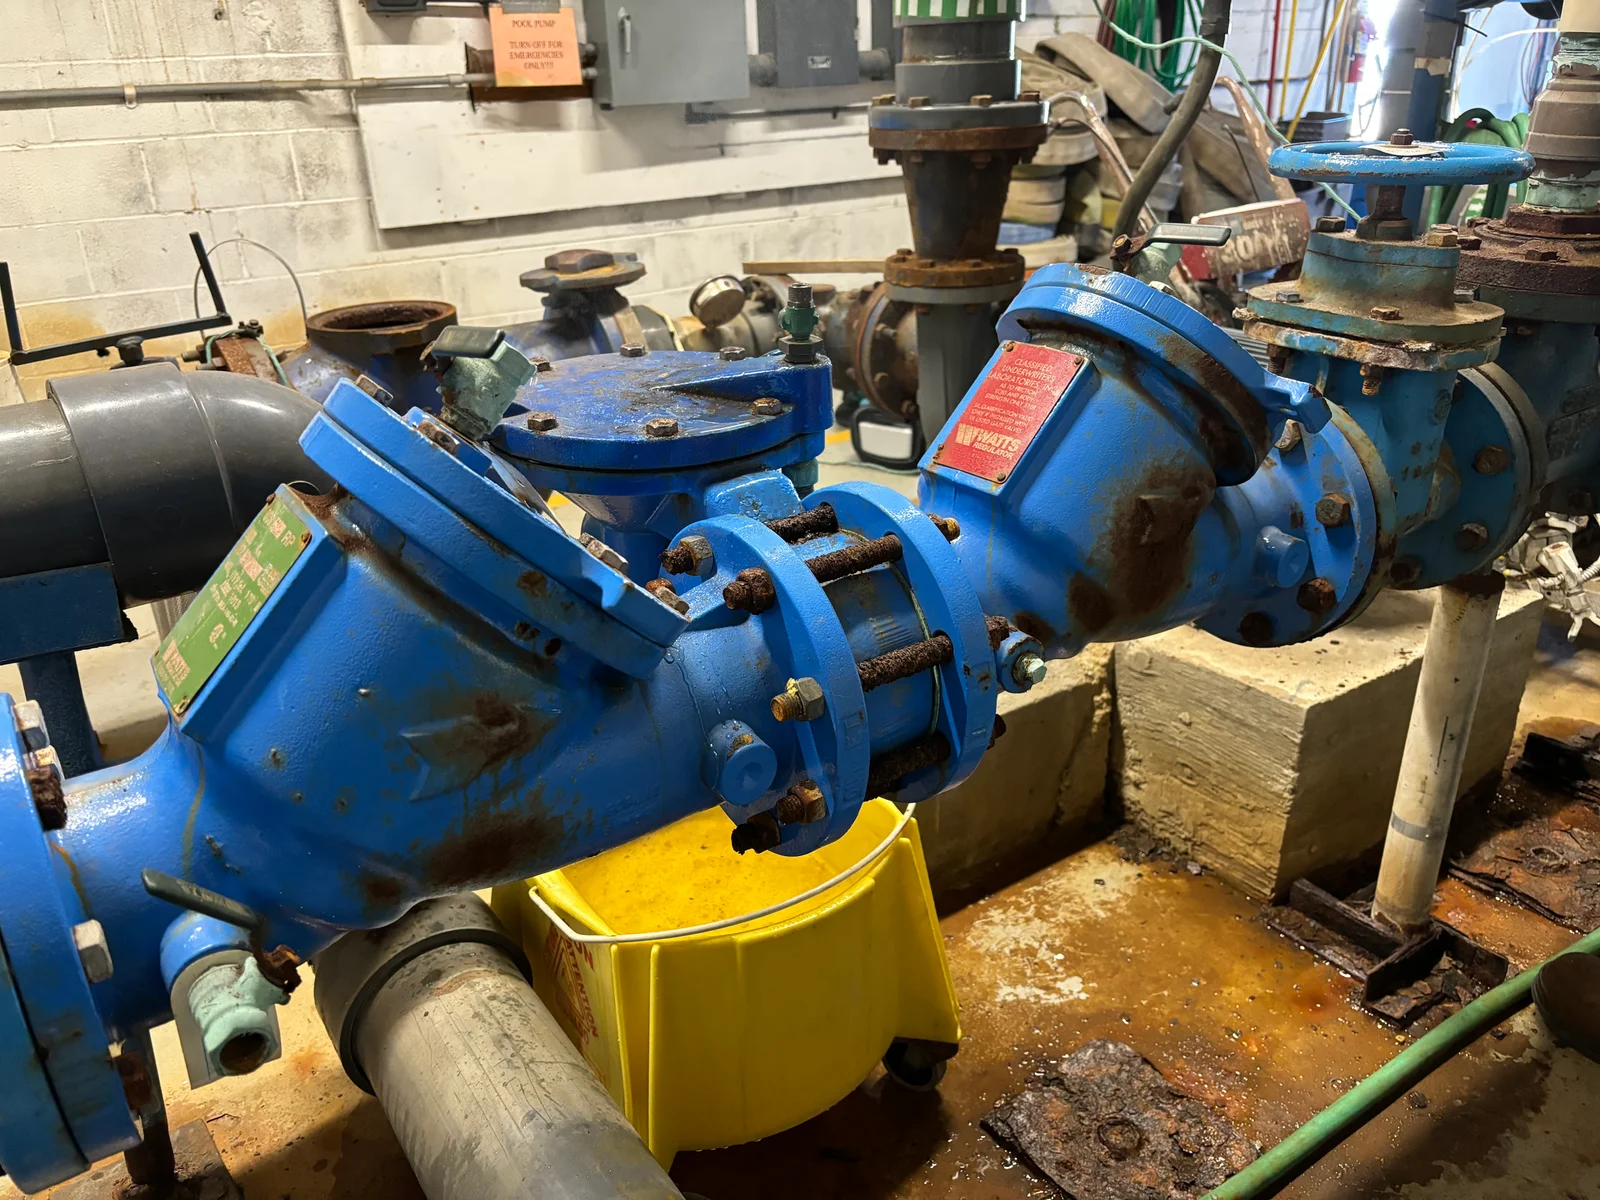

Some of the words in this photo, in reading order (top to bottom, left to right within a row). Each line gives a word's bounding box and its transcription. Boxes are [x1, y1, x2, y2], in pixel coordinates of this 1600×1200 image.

[512, 19, 532, 28] POOL
[534, 19, 556, 28] PUMP
[509, 41, 531, 49] TURN
[532, 41, 546, 49] OFF
[509, 51, 564, 60] EMERGENCIES
[972, 441, 1014, 460] REGULATOR
